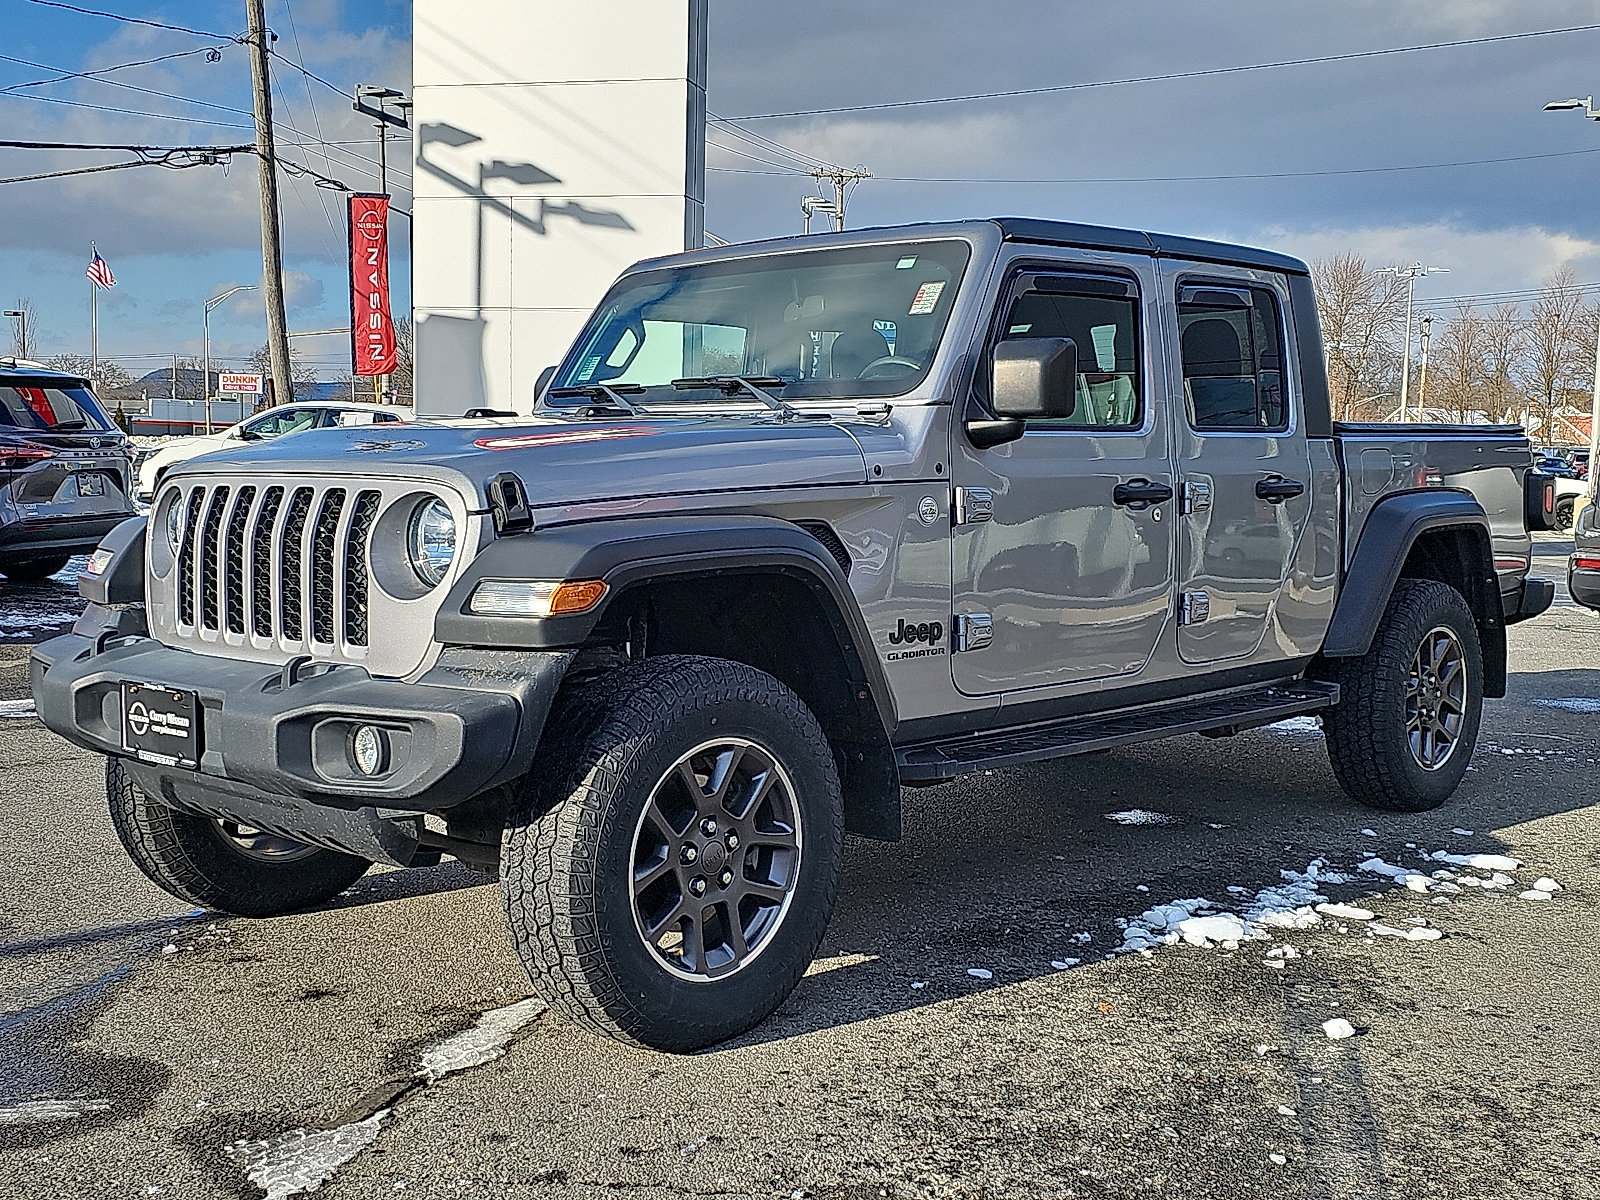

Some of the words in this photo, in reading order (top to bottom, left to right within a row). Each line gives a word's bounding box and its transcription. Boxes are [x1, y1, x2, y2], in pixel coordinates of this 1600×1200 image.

[357, 222, 384, 230] NISSAN
[367, 247, 385, 362] NISSAN
[888, 618, 943, 646] Jeep
[887, 647, 946, 661] GLADIATOR
